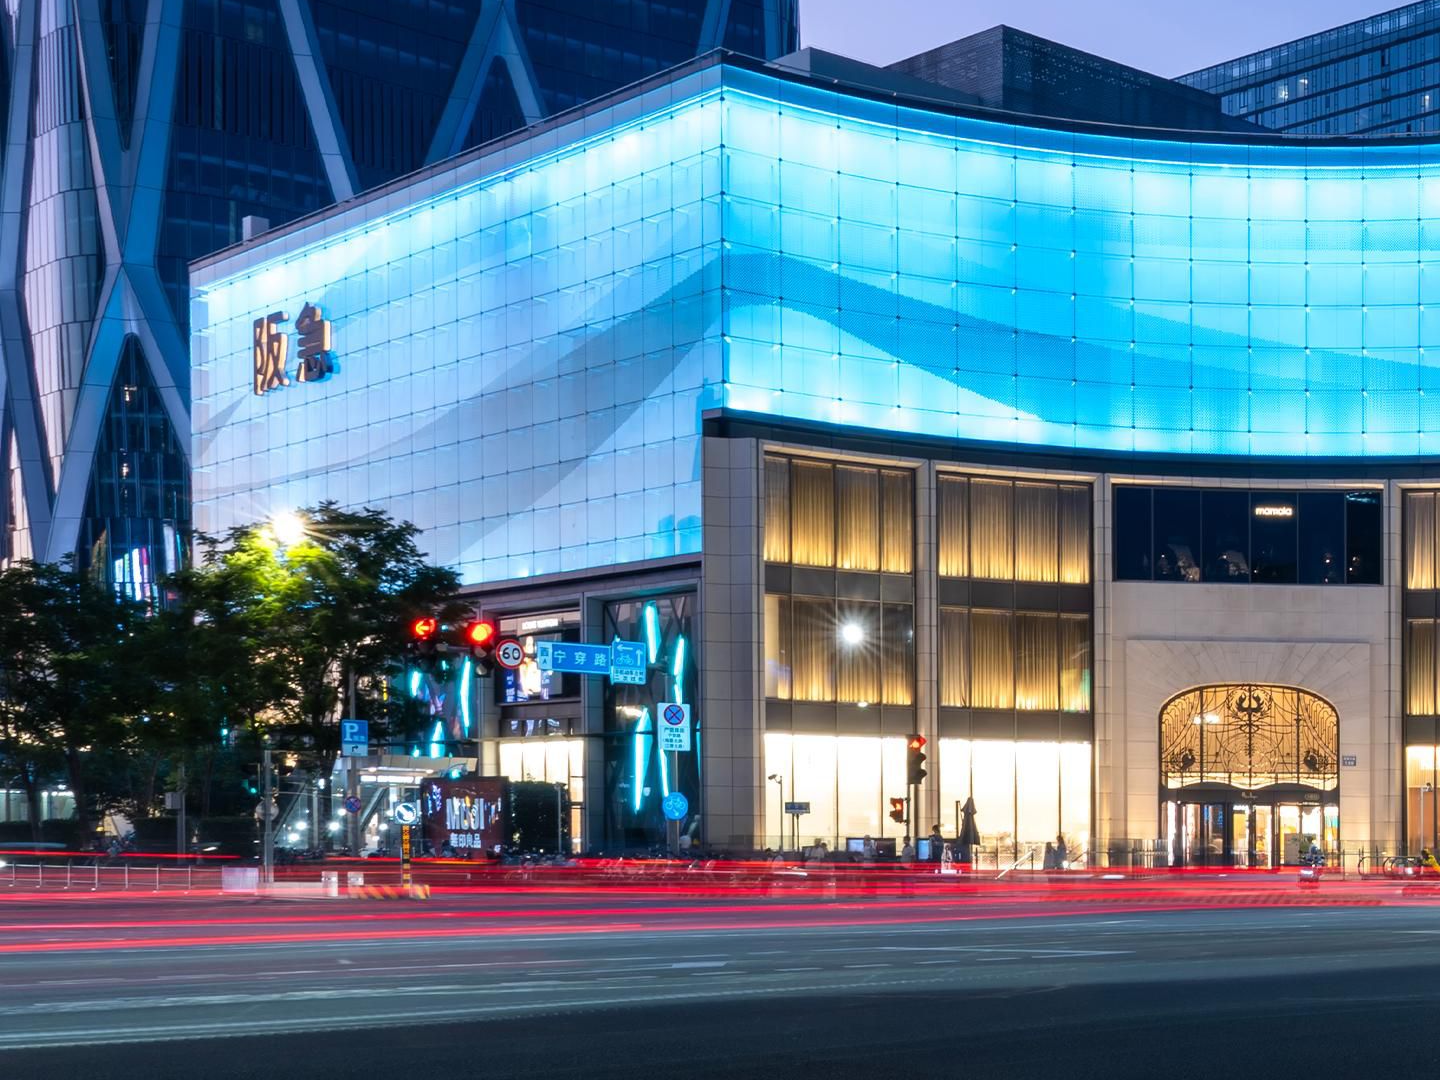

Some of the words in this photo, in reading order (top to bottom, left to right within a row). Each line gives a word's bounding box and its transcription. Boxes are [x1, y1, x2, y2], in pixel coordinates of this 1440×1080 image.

[253, 302, 335, 395] 阪急
[502, 646, 521, 661] 60
[553, 649, 608, 667] 宁穿路
[343, 722, 360, 742] P
